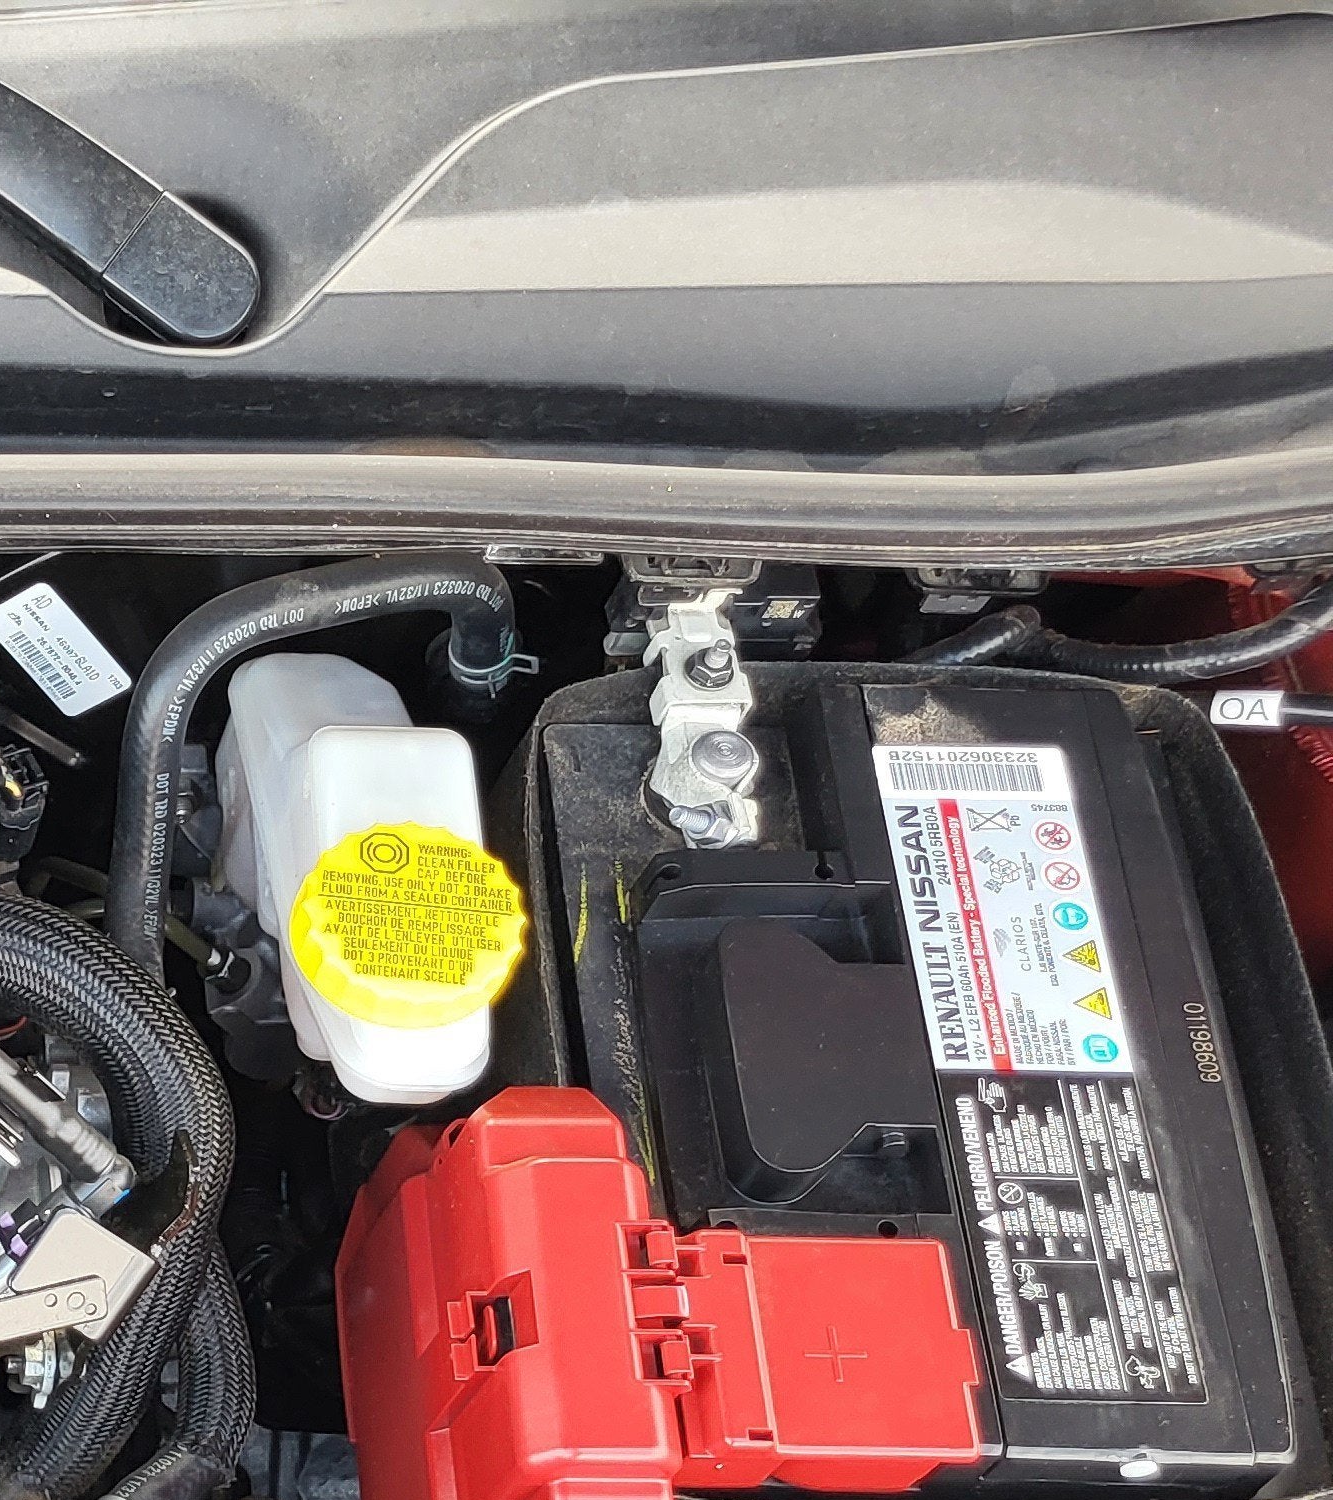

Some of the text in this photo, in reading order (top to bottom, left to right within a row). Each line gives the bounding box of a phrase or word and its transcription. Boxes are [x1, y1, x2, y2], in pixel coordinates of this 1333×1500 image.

[30, 590, 53, 612] AD
[22, 601, 50, 633] NISSAN
[283, 608, 304, 626] DOT
[212, 620, 257, 655] 020323
[155, 772, 170, 793] DOT
[1008, 815, 1021, 825] Pb
[417, 844, 471, 859] WARNING:
[944, 816, 969, 871] technology
[417, 856, 495, 873] CLEAN FILLER
[417, 868, 486, 884] CAP BEFORE
[931, 850, 951, 884] 24410
[321, 882, 352, 895] FLUID
[357, 886, 388, 898] FROM
[391, 889, 399, 899] A
[403, 891, 447, 905] SEALED
[384, 876, 403, 888] USE
[406, 879, 434, 892] ONLY
[439, 882, 458, 894] DOT
[463, 885, 469, 895] 3
[473, 885, 511, 899] BRAKE
[956, 873, 977, 910] Special
[338, 912, 486, 937] BOUCHON DE REMPLISSAGE
[424, 909, 482, 925] NETTOYER
[485, 916, 499, 927] LE
[945, 911, 963, 933] (EN)
[323, 923, 363, 936] AVANT
[367, 927, 380, 938] DE
[451, 936, 501, 951] UTILISER
[894, 805, 970, 1061] RENAULT NISSAN
[966, 919, 986, 955] Battery
[1009, 916, 1032, 971] CLARIOS
[343, 937, 473, 960] SEULEMENT DU LIQUIDE
[343, 949, 363, 961] DOT
[368, 952, 374, 962] 3
[377, 952, 443, 969] PROVENANT
[951, 936, 967, 961] 510A
[354, 963, 419, 980] CONTENANT
[957, 965, 973, 991] 60Ah
[974, 958, 995, 1000] Flooded
[962, 994, 978, 1015] EFB
[967, 1018, 981, 1031] L2
[983, 1003, 1006, 1054] Enhanced
[972, 1041, 987, 1060] 12V
[1183, 1001, 1221, 1084] 01198609
[954, 1097, 993, 1210] PELIGRO/VENENO
[983, 1240, 1023, 1354] DANGER/POISON
